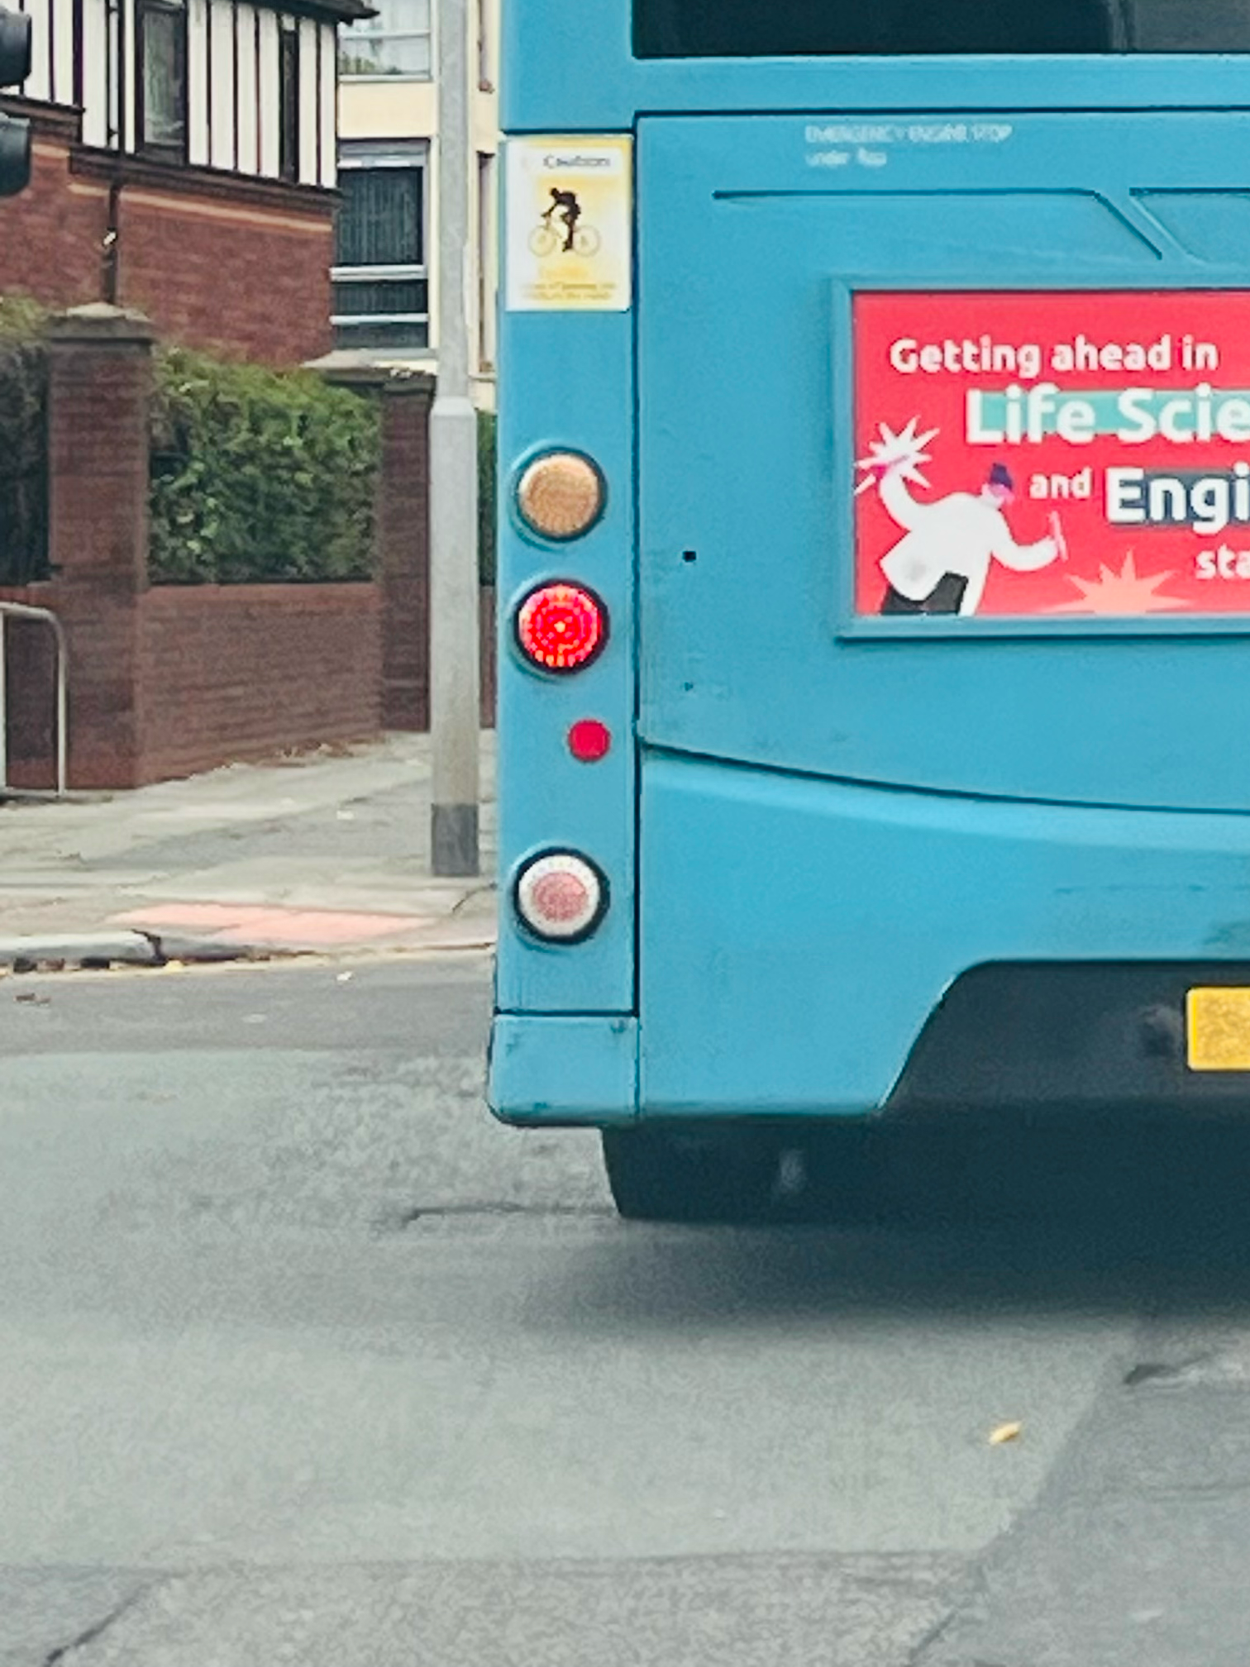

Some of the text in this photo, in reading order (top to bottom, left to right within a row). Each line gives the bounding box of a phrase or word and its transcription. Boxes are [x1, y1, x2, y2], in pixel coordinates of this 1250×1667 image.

[890, 335, 1218, 380] Getting ahead in
[966, 383, 1097, 445] Life
[1029, 467, 1093, 501] and
